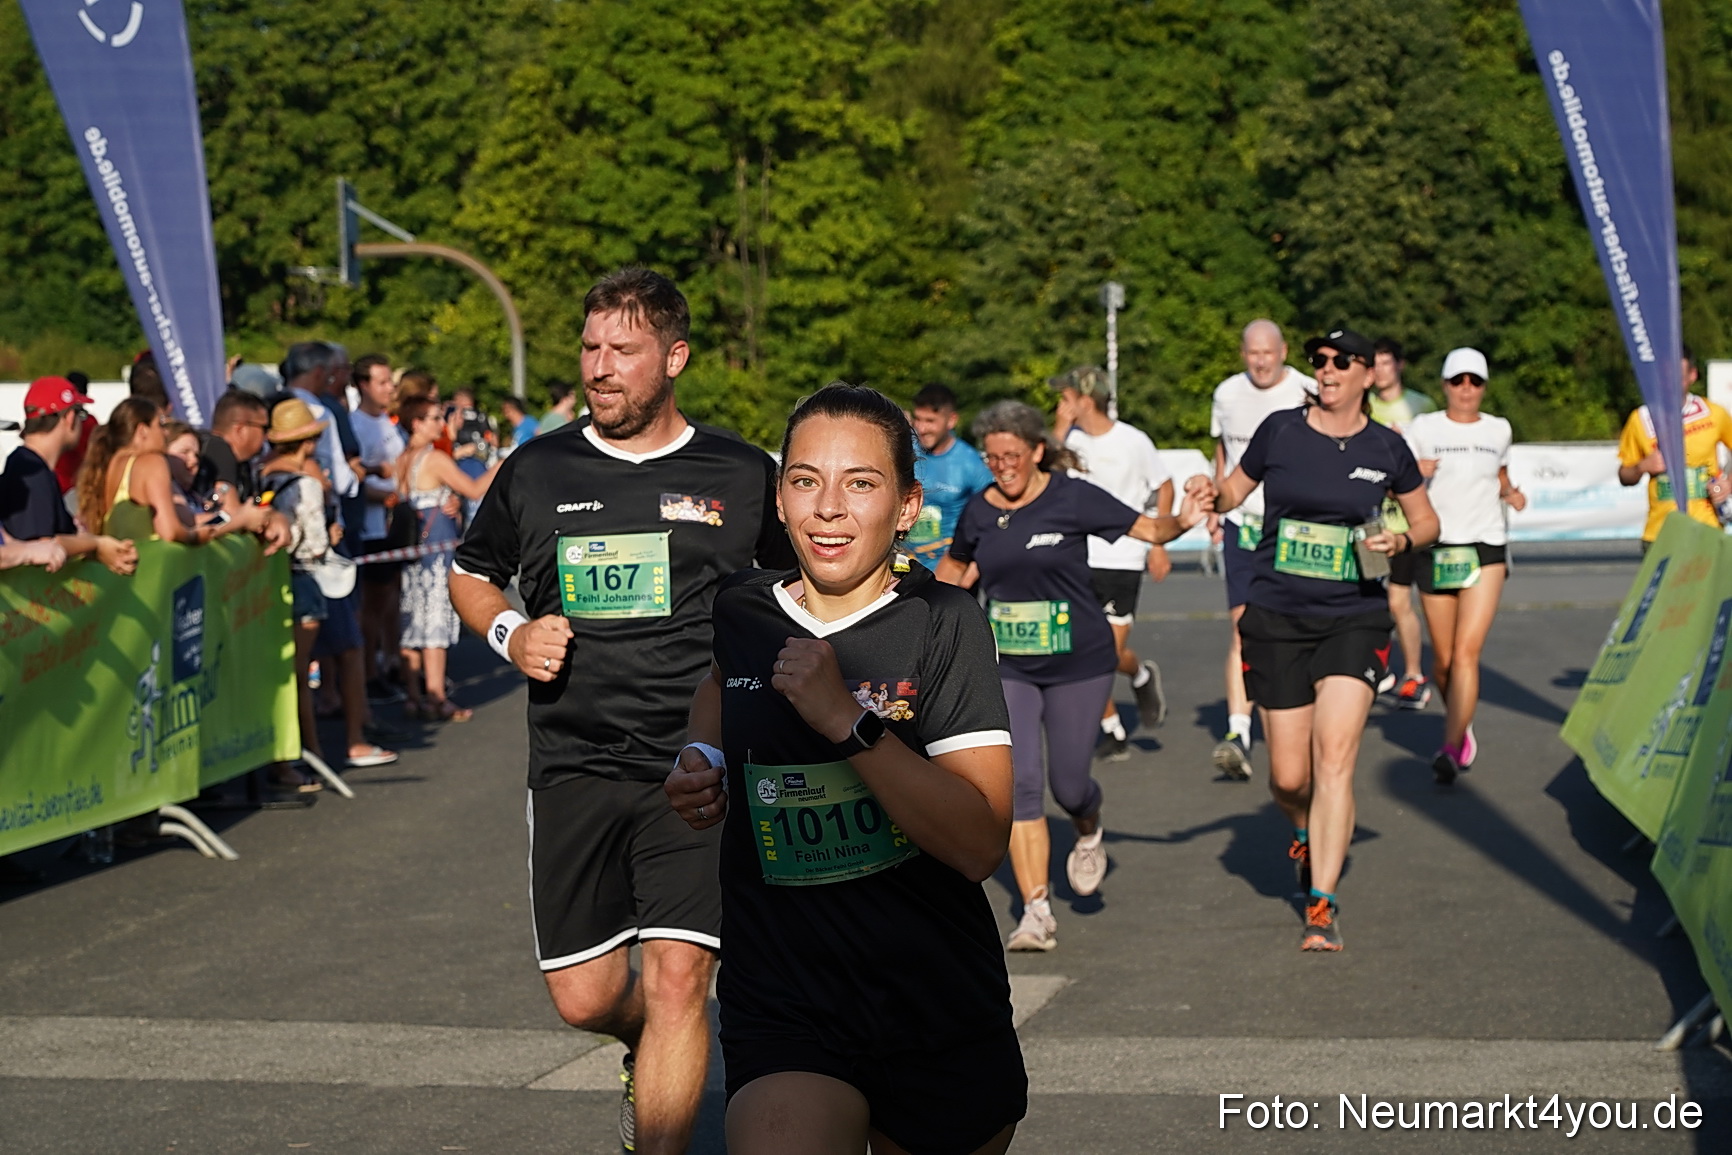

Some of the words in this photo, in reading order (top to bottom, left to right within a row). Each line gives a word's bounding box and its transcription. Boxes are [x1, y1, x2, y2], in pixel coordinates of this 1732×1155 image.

[556, 501, 593, 513] CRAFT
[1289, 541, 1334, 561] 1163
[564, 573, 576, 602] RUN
[586, 564, 640, 591] 167
[653, 566, 665, 605] 2022
[577, 593, 600, 603] Feihl
[602, 593, 653, 603] Johannes
[996, 621, 1038, 638] 1162
[726, 677, 751, 688] CRAFT
[779, 784, 826, 799] Firmenlauf
[797, 793, 827, 802] neumarkt
[773, 797, 882, 847] 1010
[759, 820, 778, 861] RUN
[795, 844, 831, 863] Feihl
[834, 842, 871, 858] Nina
